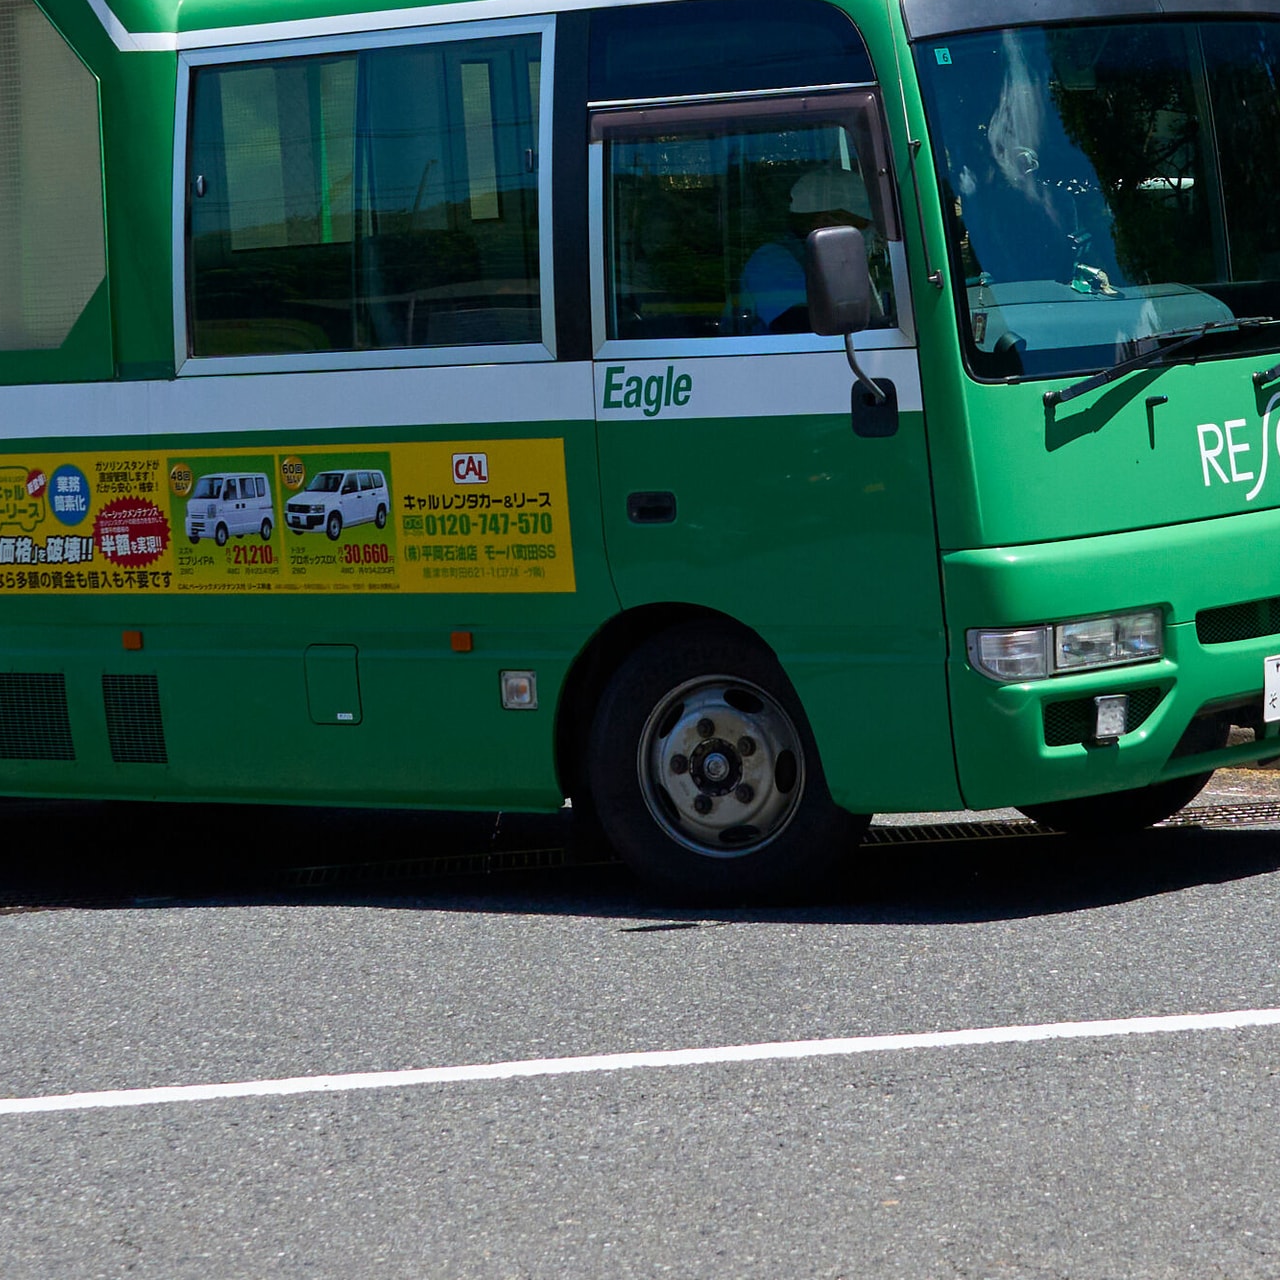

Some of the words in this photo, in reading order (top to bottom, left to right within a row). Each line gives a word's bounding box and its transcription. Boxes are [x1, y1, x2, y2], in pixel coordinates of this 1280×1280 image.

[603, 365, 692, 417] Eagle
[95, 460, 159, 471] ガソリンスタンドが
[282, 463, 303, 474] 60回
[454, 455, 487, 481] CAL
[57, 476, 80, 492] 業務
[171, 471, 191, 481] 48回
[54, 495, 86, 512] 簡素化
[403, 492, 552, 510] キャルレンタカー&リース
[101, 507, 159, 519] ベーシックメンテナンス
[425, 512, 553, 536] 0120-747-570
[101, 533, 163, 557] 半額を実現!!
[403, 544, 477, 561] (株)平岡石油店
[178, 556, 215, 566] エブリイPA
[290, 555, 337, 565] プロボックスDX
[1269, 692, 1278, 708] そ
